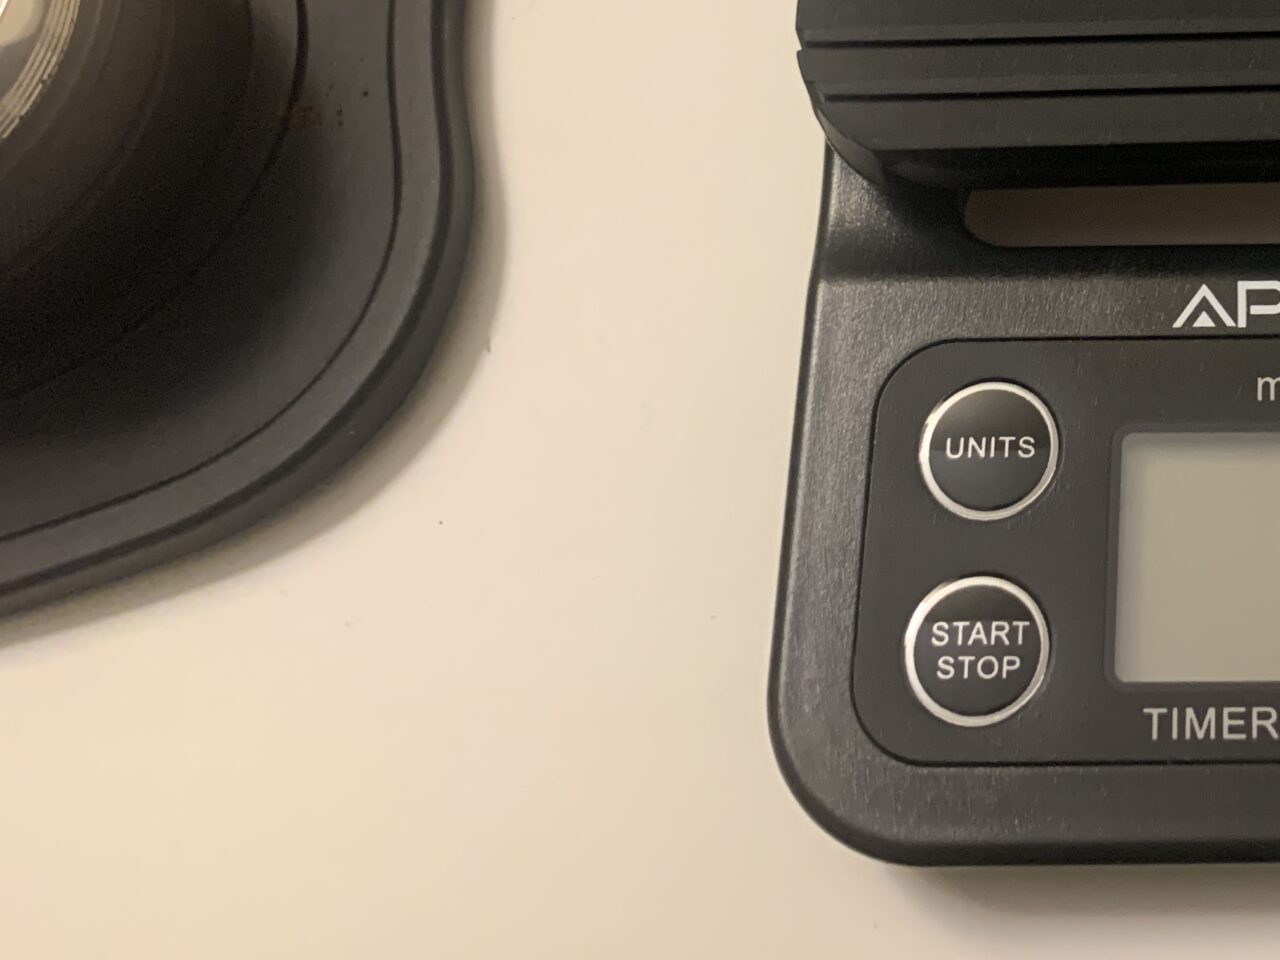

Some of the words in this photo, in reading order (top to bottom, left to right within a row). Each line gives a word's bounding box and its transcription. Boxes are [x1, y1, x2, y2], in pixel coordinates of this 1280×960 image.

[945, 436, 1036, 459] UNITS
[930, 620, 1030, 647] START
[936, 655, 1021, 680] STOP
[1143, 706, 1280, 741] TIMER
